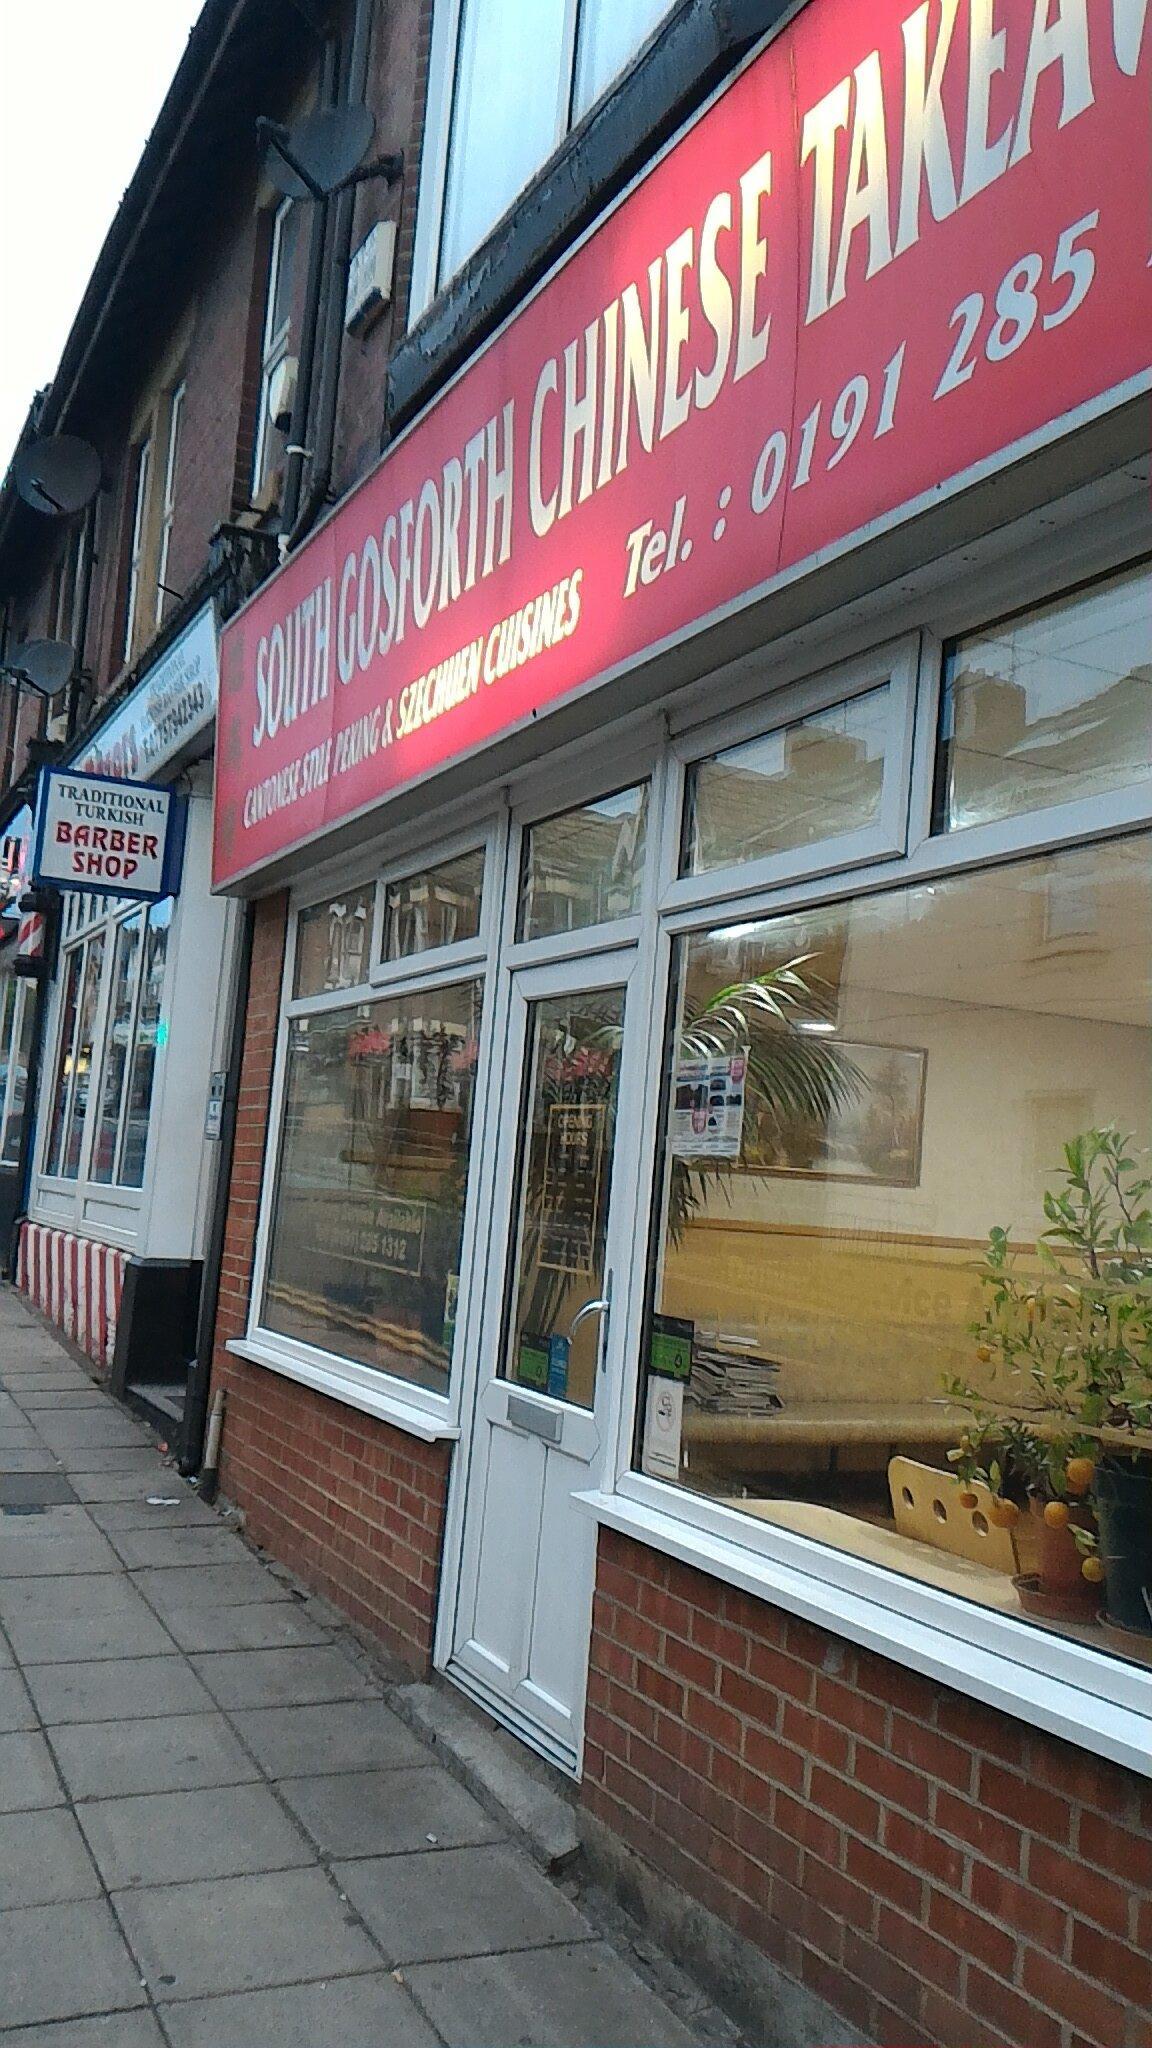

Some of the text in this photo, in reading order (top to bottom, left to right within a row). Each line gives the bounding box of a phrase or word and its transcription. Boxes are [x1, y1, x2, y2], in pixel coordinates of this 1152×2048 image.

[622, 494, 694, 599] Tel.
[750, 340, 907, 515] 0191
[932, 208, 1101, 401] 285
[252, 576, 333, 748] SOUTH
[336, 398, 515, 685] GOSFORTH
[528, 150, 773, 538] CHINESE
[332, 704, 381, 776] PEKING
[483, 567, 584, 686] CUISINES
[58, 783, 165, 815] TRADITIONAL
[75, 802, 145, 826] TURKISH
[55, 820, 159, 861] BARBER
[72, 850, 139, 880] SHOP
